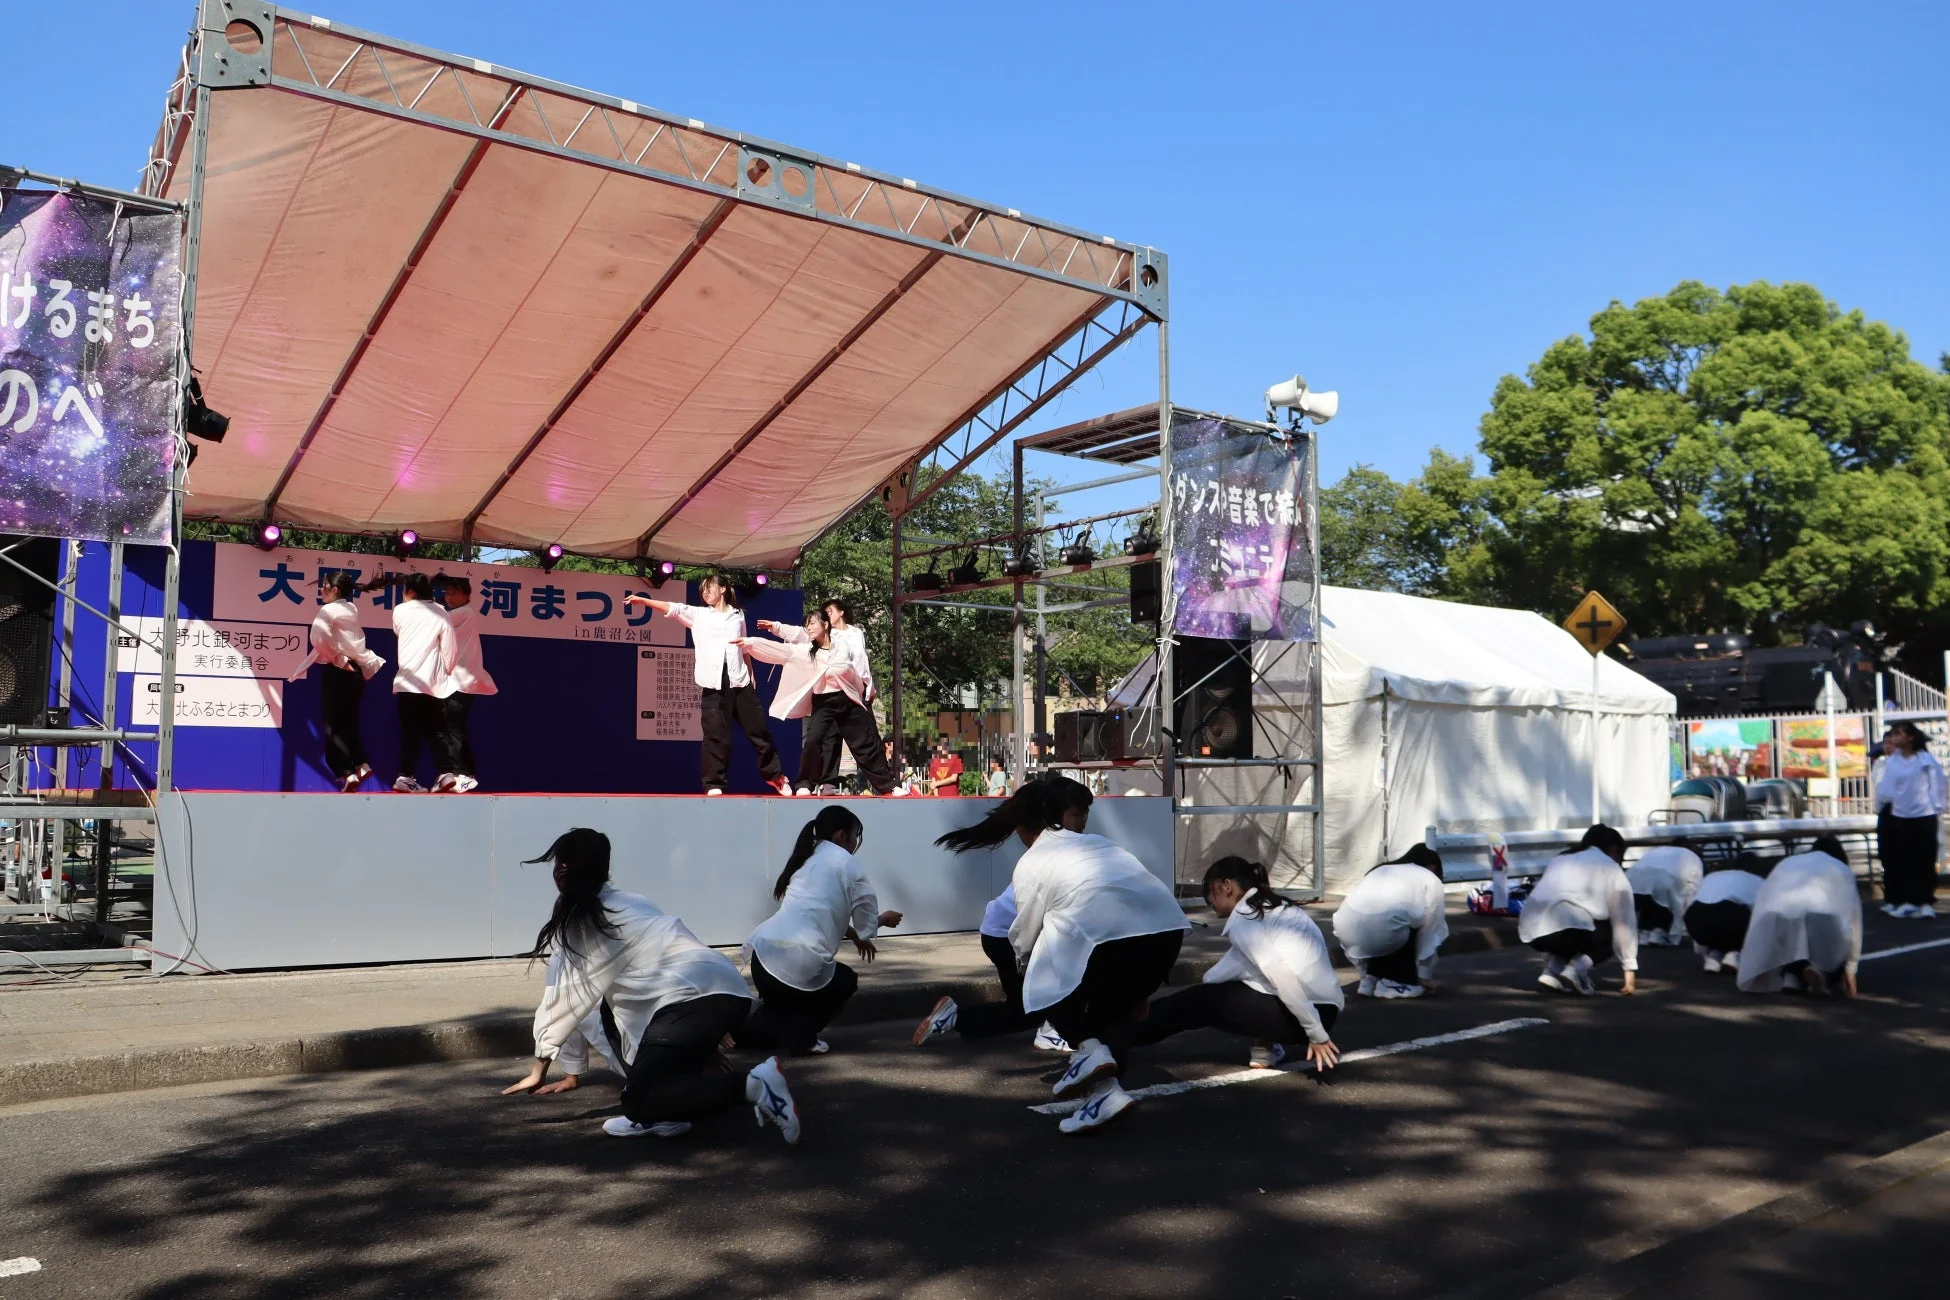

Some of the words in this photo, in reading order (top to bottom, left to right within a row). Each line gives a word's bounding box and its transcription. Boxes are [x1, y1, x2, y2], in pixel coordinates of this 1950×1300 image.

[1, 271, 155, 349] けるまち
[0, 369, 104, 438] のべ
[194, 654, 269, 671] 実行委員会
[146, 699, 271, 718] 大北ふるさとまつり
